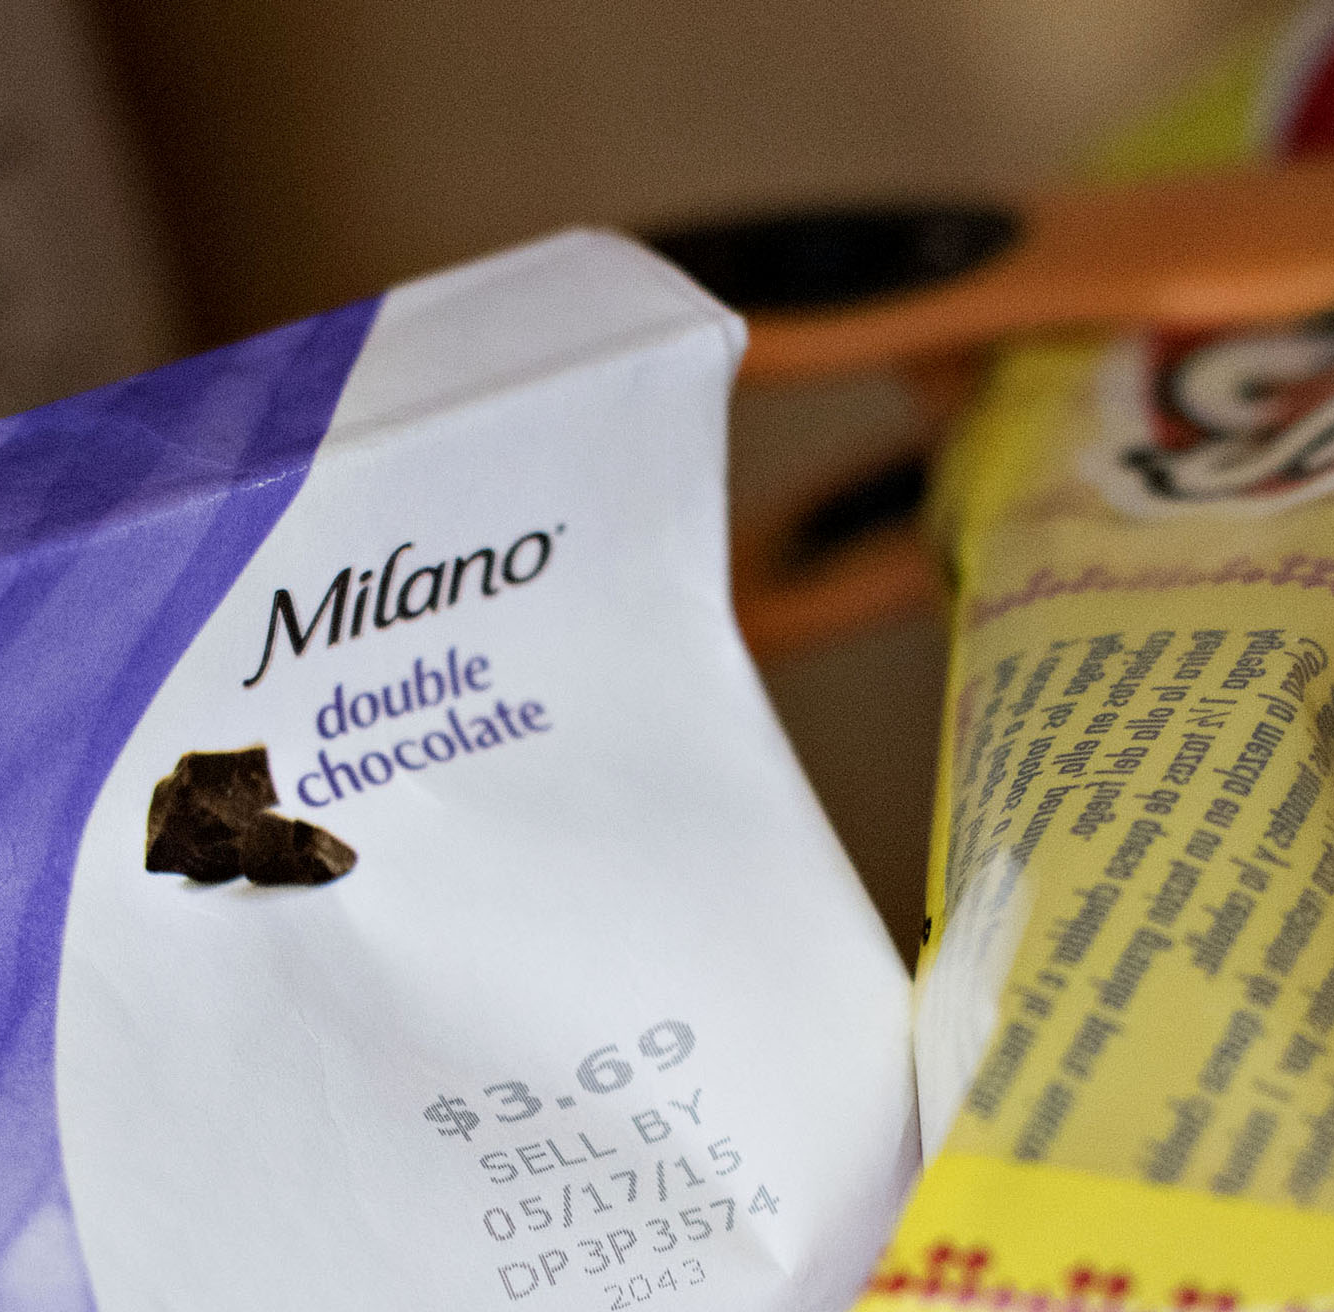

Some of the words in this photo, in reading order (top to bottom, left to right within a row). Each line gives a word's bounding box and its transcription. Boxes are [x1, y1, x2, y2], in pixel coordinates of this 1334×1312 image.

[243, 526, 553, 688] Milano
[316, 647, 494, 741] double
[295, 694, 553, 809] chocolate
[422, 1018, 697, 1142] $3.69
[478, 1129, 618, 1186] SELL
[631, 1087, 707, 1145] BY
[482, 1135, 743, 1245] 05/17/15
[497, 1182, 781, 1301] DP3P3574
[603, 1258, 707, 1312] 2043
